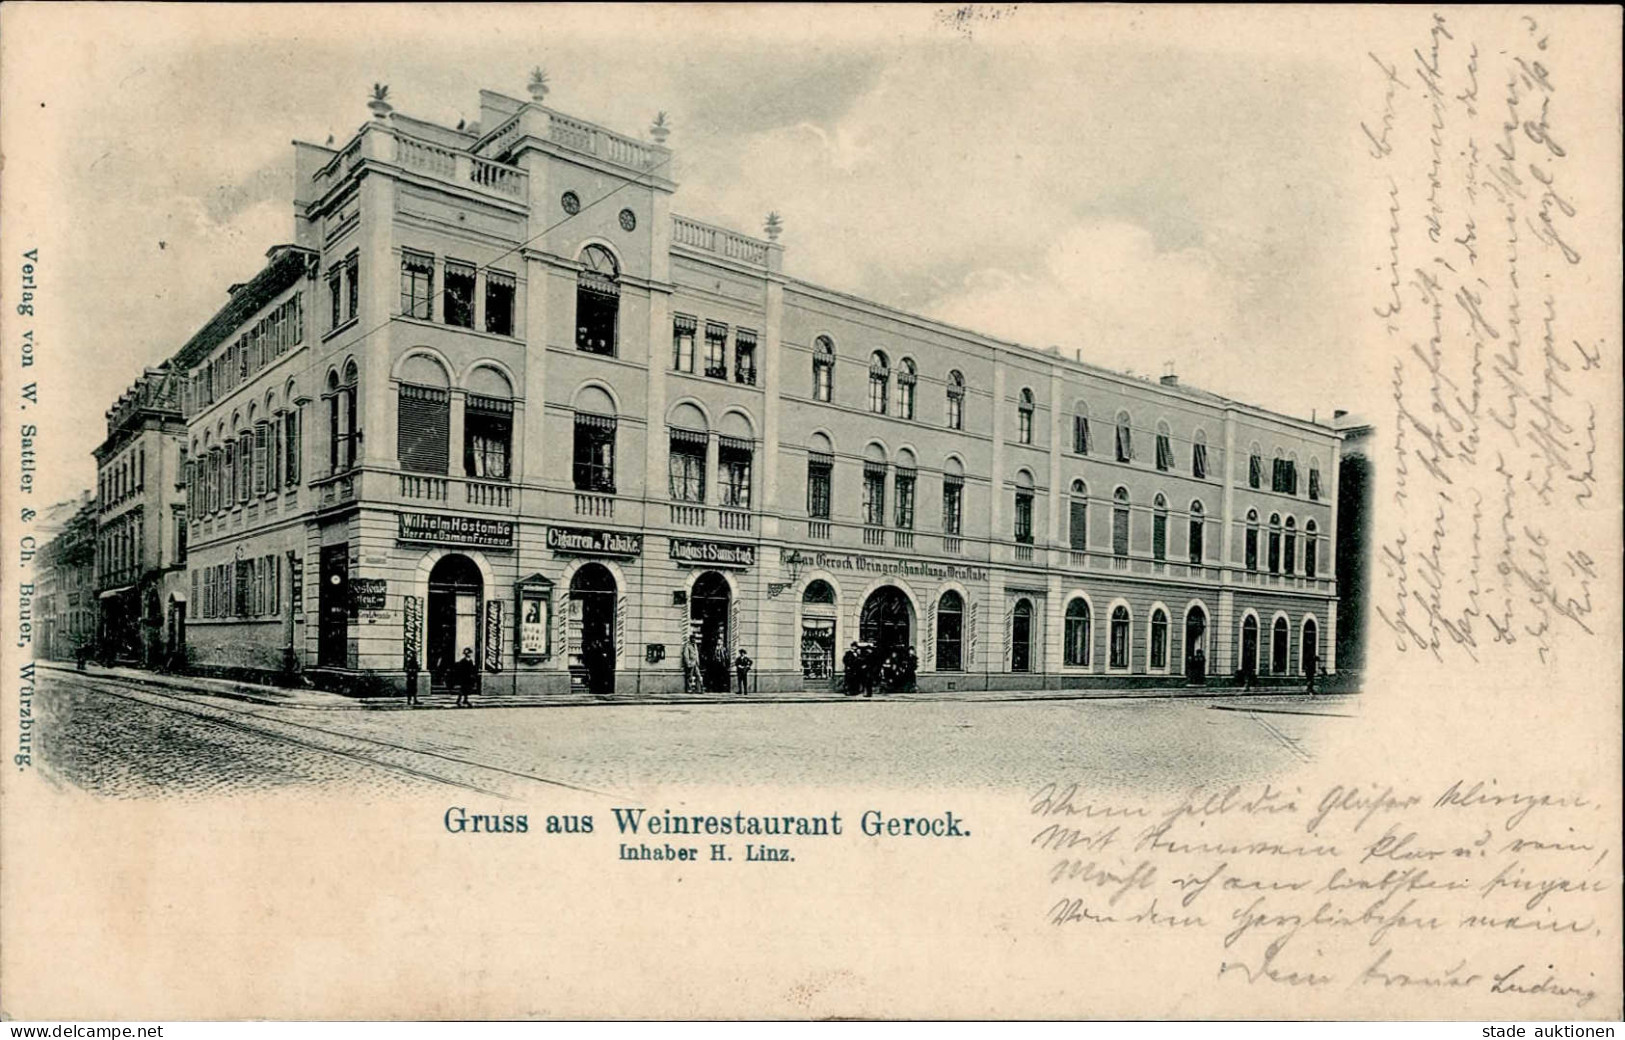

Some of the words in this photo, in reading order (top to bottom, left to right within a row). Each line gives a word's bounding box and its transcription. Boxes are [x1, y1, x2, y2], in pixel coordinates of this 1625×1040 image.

[17, 249, 37, 316] Verlag
[22, 331, 33, 367] von
[22, 383, 36, 409] W.
[21, 425, 36, 493] Sattler
[22, 508, 36, 521] &
[402, 513, 451, 530] Wilhelm
[21, 537, 37, 568] Ch.
[548, 528, 593, 549] Cigarren
[671, 540, 708, 560] August
[18, 584, 37, 651] Bauer,
[15, 662, 37, 771] Würzburg.
[445, 807, 528, 833] Gruss
[547, 816, 593, 833] aus
[611, 809, 841, 835] Weinrestaurant
[862, 811, 970, 836] Gerock.
[620, 844, 697, 861] Inhaber
[711, 845, 731, 860] H.
[747, 845, 794, 861] Linz.
